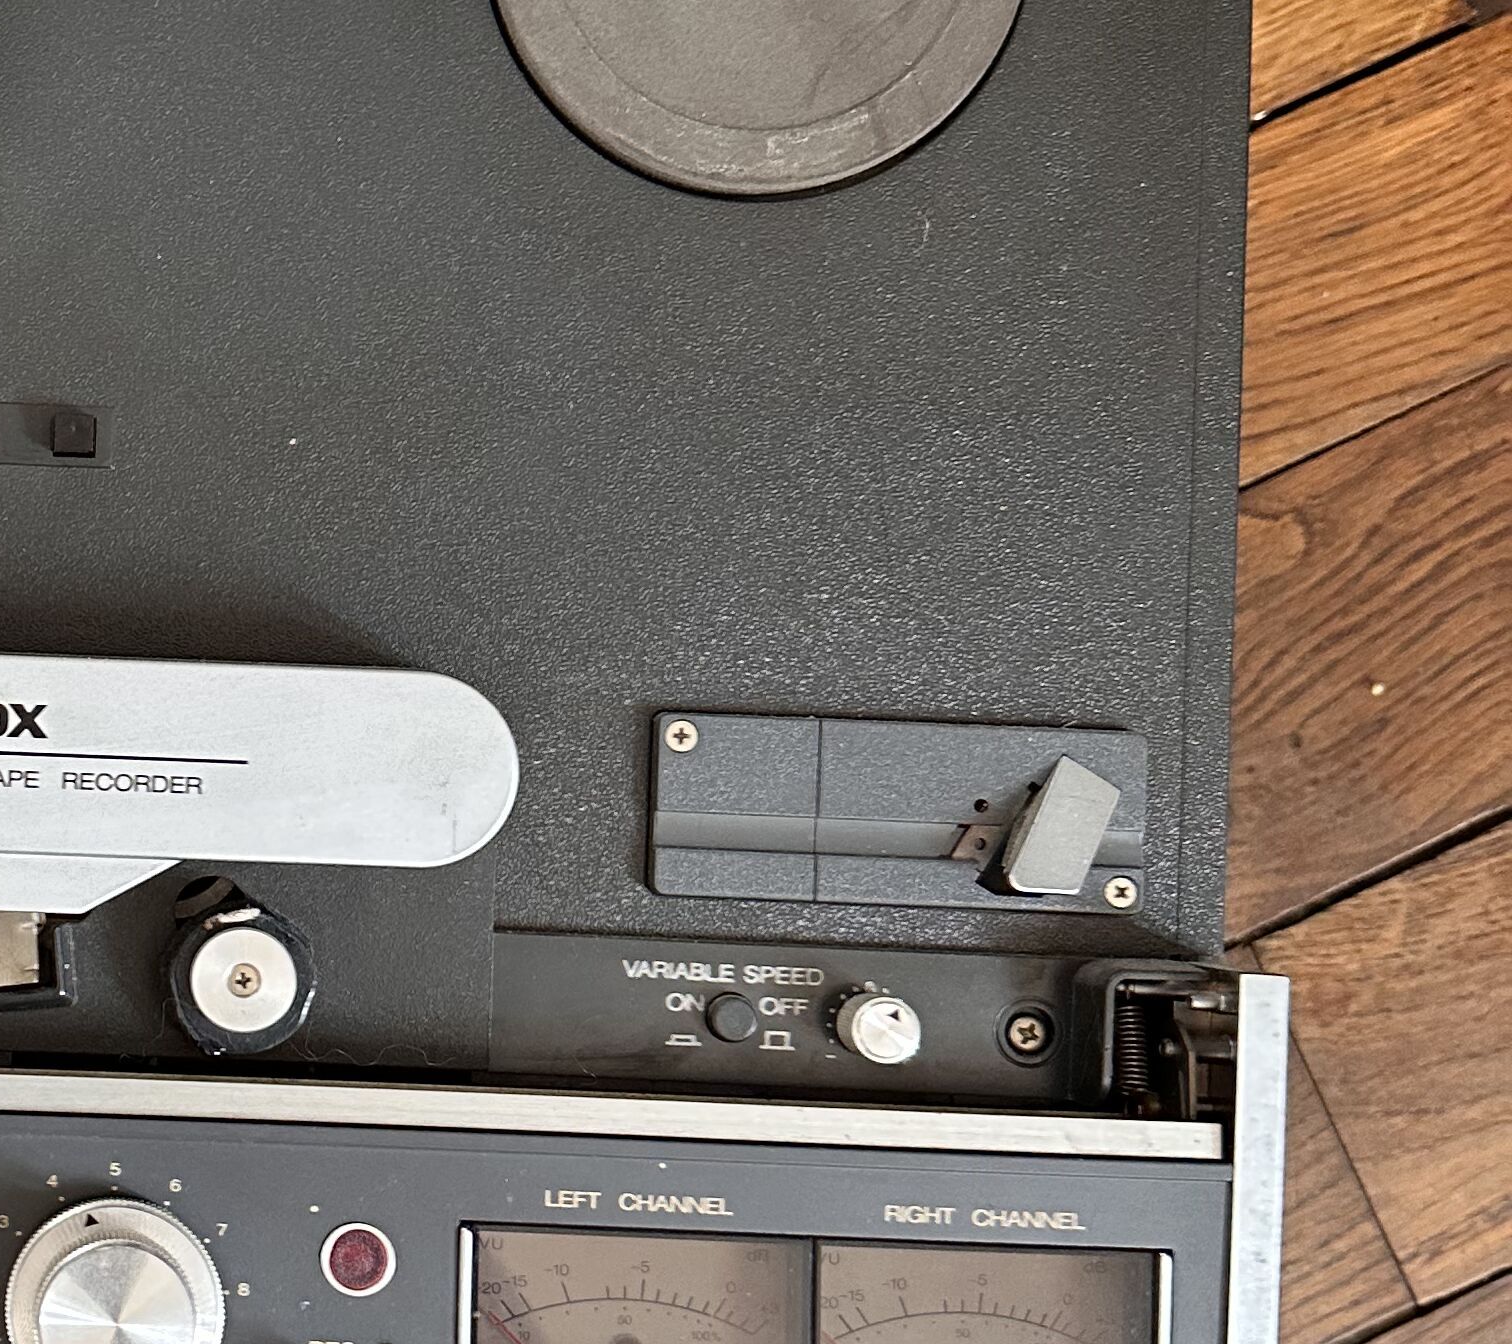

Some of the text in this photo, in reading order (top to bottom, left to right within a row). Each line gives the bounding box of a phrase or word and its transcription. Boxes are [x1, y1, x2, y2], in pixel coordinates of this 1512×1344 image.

[61, 771, 202, 795] RECORDER
[621, 959, 823, 986] VARIABLE SPEED
[665, 992, 703, 1012] ON
[758, 996, 809, 1016] OFF
[544, 1189, 735, 1216] LEFT CHANNEL
[46, 1174, 59, 1187] 4
[109, 1162, 122, 1177] 5
[169, 1178, 182, 1193] 6
[216, 1223, 229, 1237] 7
[237, 1282, 251, 1297] 8
[883, 1204, 1087, 1231] RIGHT CHANNEL
